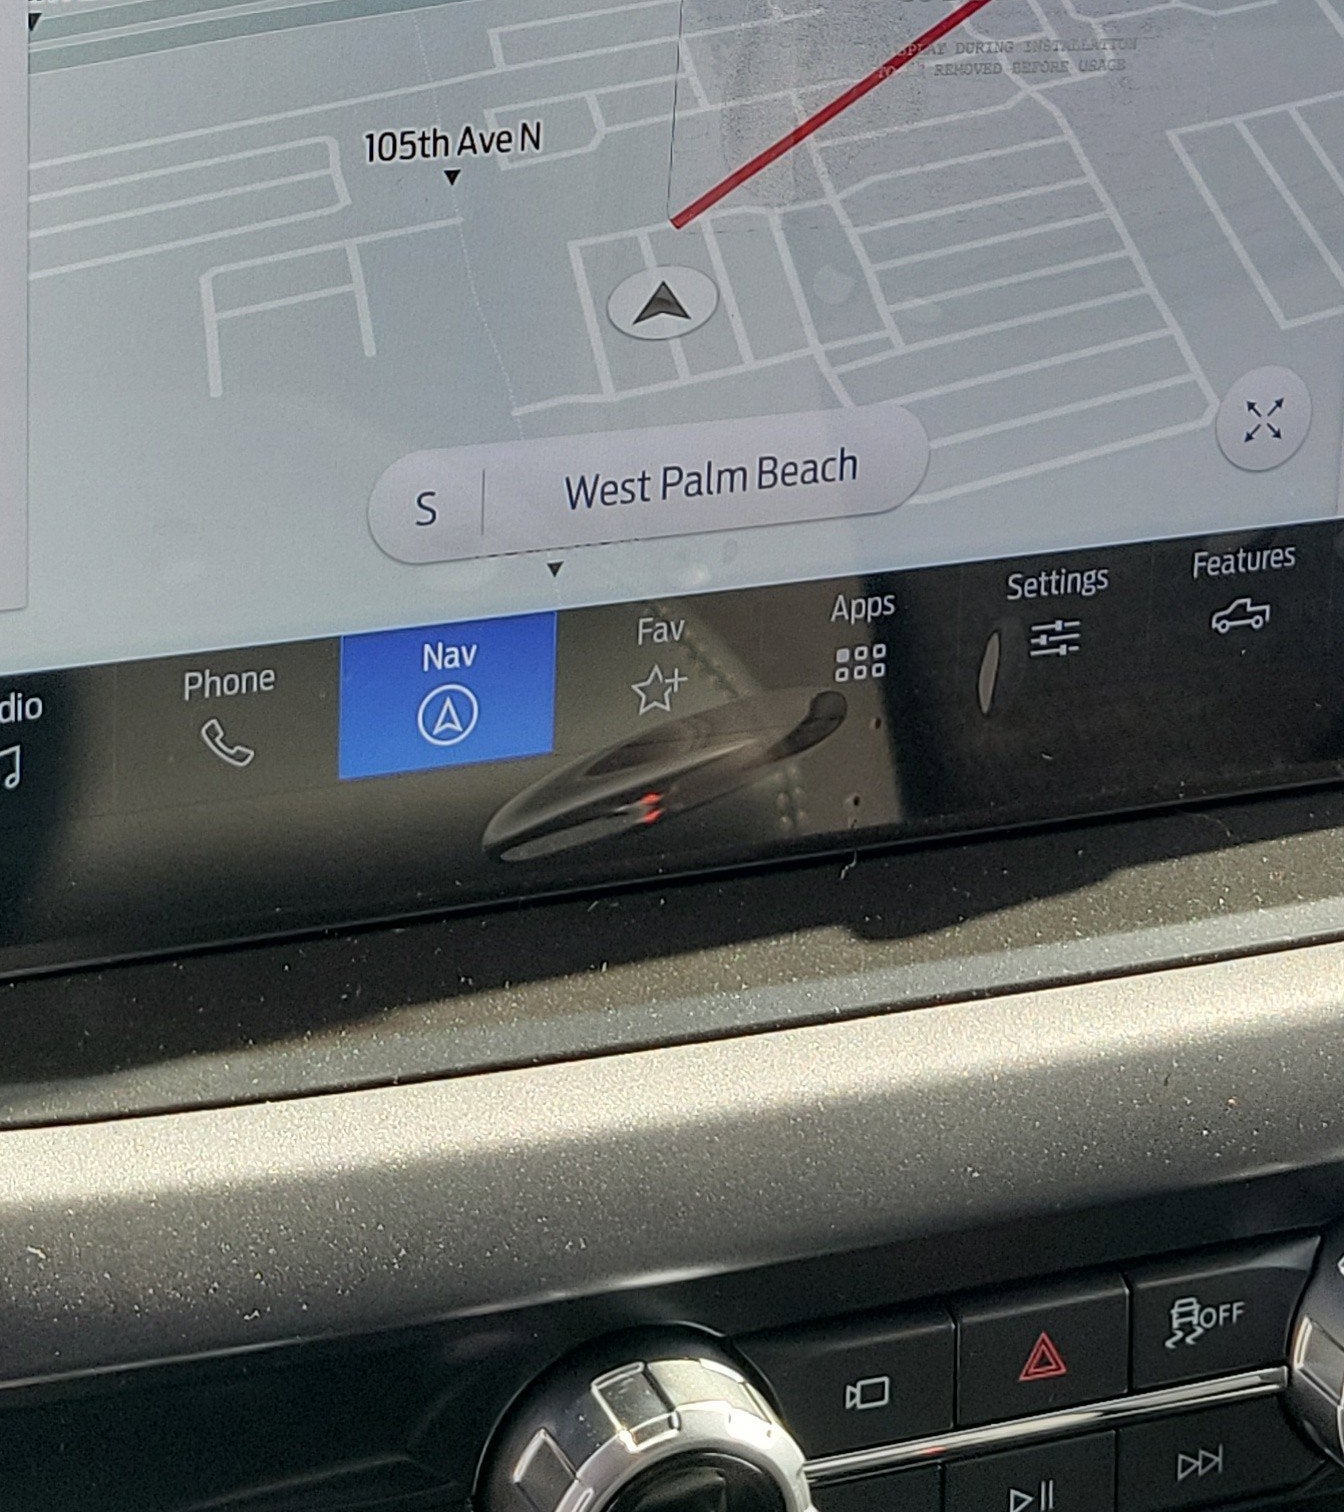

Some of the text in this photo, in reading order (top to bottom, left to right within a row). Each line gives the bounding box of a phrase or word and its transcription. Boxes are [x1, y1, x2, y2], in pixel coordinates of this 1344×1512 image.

[934, 62, 1002, 77] REMOVED
[365, 123, 541, 162] 105th Ave N
[415, 447, 857, 527] S West Palm Beach
[1193, 543, 1296, 579] Features
[1007, 566, 1109, 601] Settings
[831, 592, 896, 624] Apps
[637, 616, 685, 646] Fav
[422, 641, 477, 671] Nav
[184, 666, 276, 701] Phone
[1199, 1300, 1245, 1329] OFF
